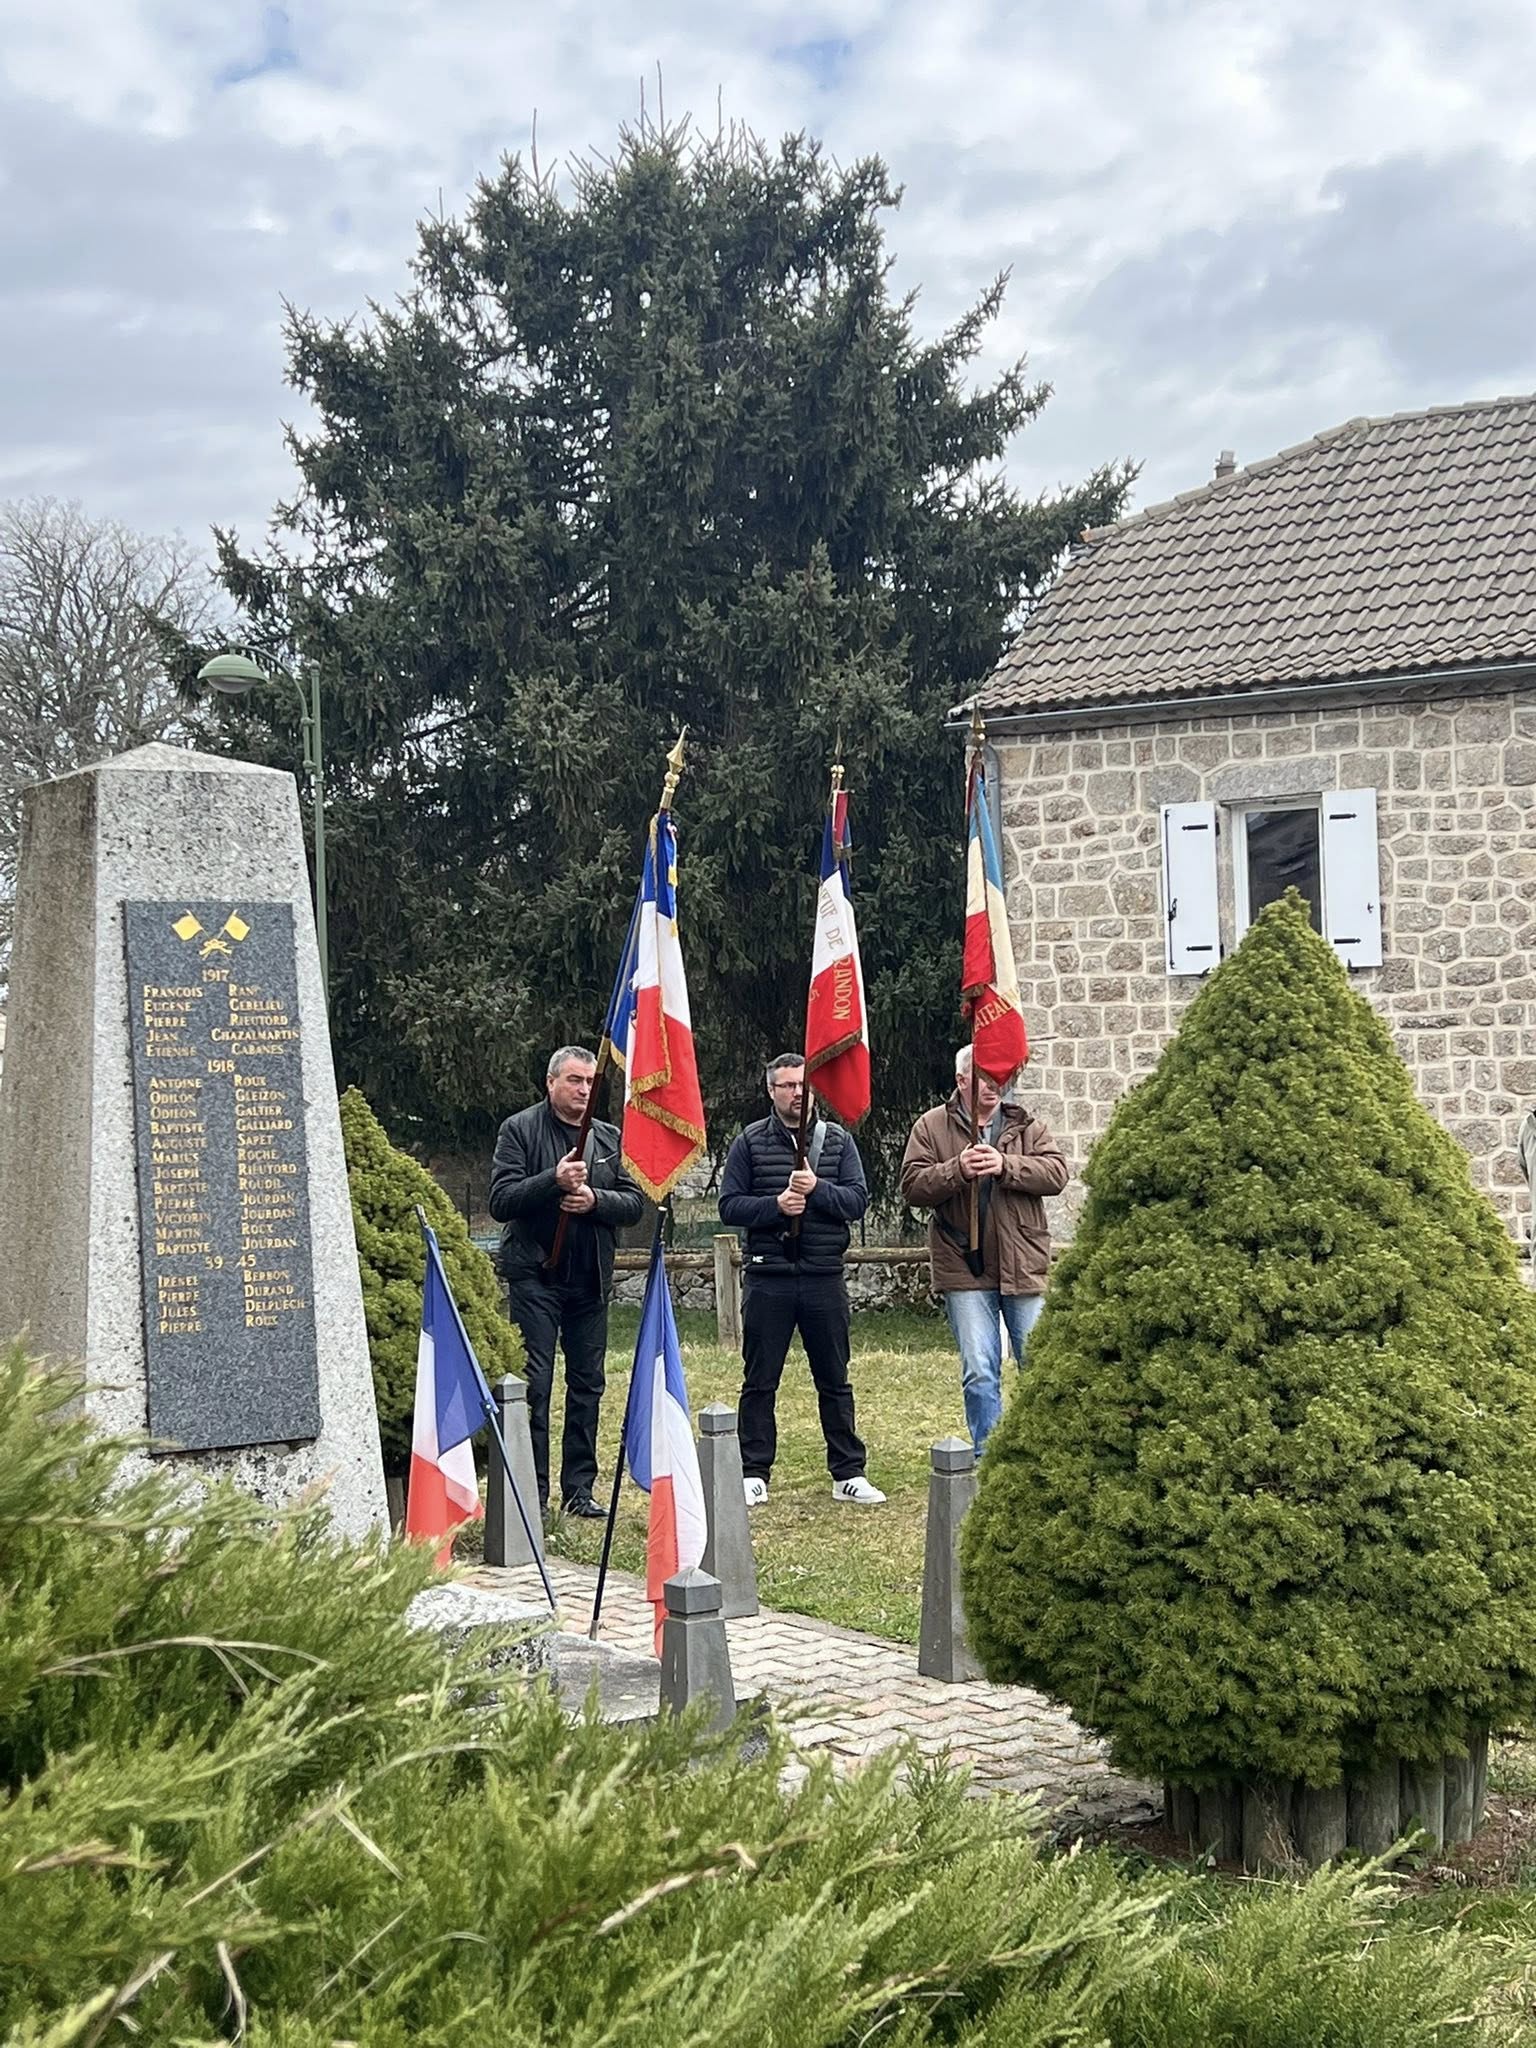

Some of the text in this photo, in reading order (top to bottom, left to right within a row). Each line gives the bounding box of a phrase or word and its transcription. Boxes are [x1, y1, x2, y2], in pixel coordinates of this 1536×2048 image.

[825, 927, 844, 950] DE
[202, 968, 230, 982] 1917
[143, 984, 204, 998] FRANCOIS
[832, 956, 853, 1020] RANDON
[144, 1014, 188, 1027] PIERRE
[146, 1029, 179, 1042] JEAN
[207, 1060, 236, 1073] 1918
[149, 1077, 203, 1089] ANTOINE
[151, 1137, 209, 1150] AUGUSTE
[151, 1167, 200, 1180] JOSEPH
[156, 1237, 297, 1256] BAPTISTE JOURDAN
[244, 1284, 294, 1298] DURAND
[160, 1305, 198, 1319] JULES
[160, 1320, 203, 1334] PIERRE
